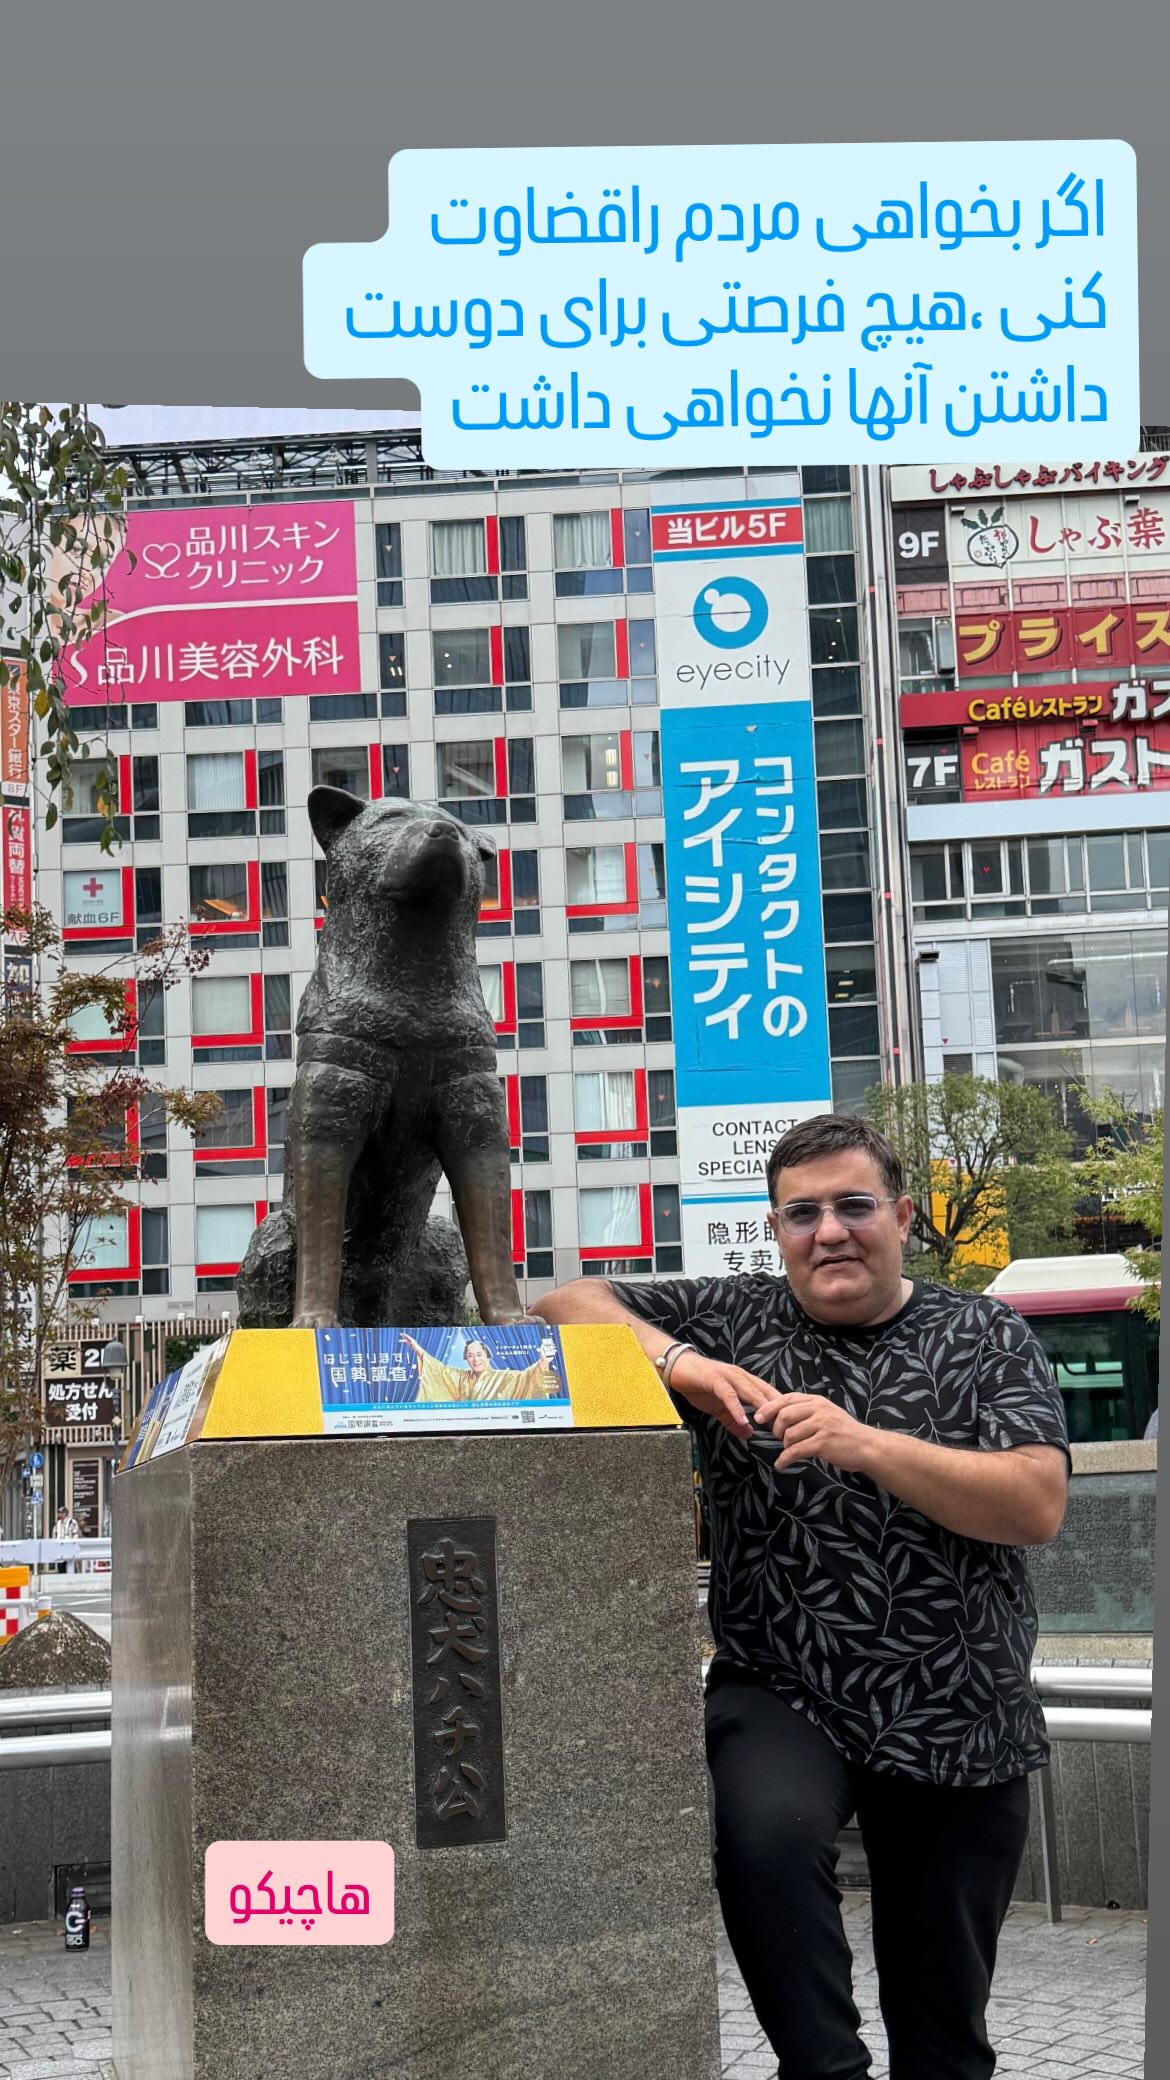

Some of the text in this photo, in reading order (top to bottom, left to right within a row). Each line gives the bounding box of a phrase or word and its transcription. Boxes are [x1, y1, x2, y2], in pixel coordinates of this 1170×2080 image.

[929, 455, 1170, 493] しゃぶしゃぶバイキング
[186, 520, 340, 557] 品川スキン
[666, 512, 788, 545] 当ビル5F
[898, 531, 940, 558] 9F
[1029, 507, 1167, 554] しゃぶ葉
[188, 554, 324, 590] クリニック
[97, 634, 345, 685] 品川美容外科
[676, 654, 790, 690] eyecity
[907, 755, 959, 788] 7F
[971, 750, 1031, 775] Café
[1039, 737, 1170, 793] ガスト
[974, 775, 1031, 791] レストラン
[680, 759, 752, 1040] アイシティ
[754, 756, 808, 1038] コンタクトの
[67, 912, 120, 925] 献血6F
[712, 1119, 798, 1137] CONTACT
[723, 1249, 784, 1274] 专卖
[50, 1347, 77, 1372] 薬
[330, 1366, 408, 1384] 国勢調査
[48, 1382, 114, 1402] 処方せん
[65, 1403, 99, 1422] 受付
[417, 1537, 490, 1822] 忠犬ハチ公
